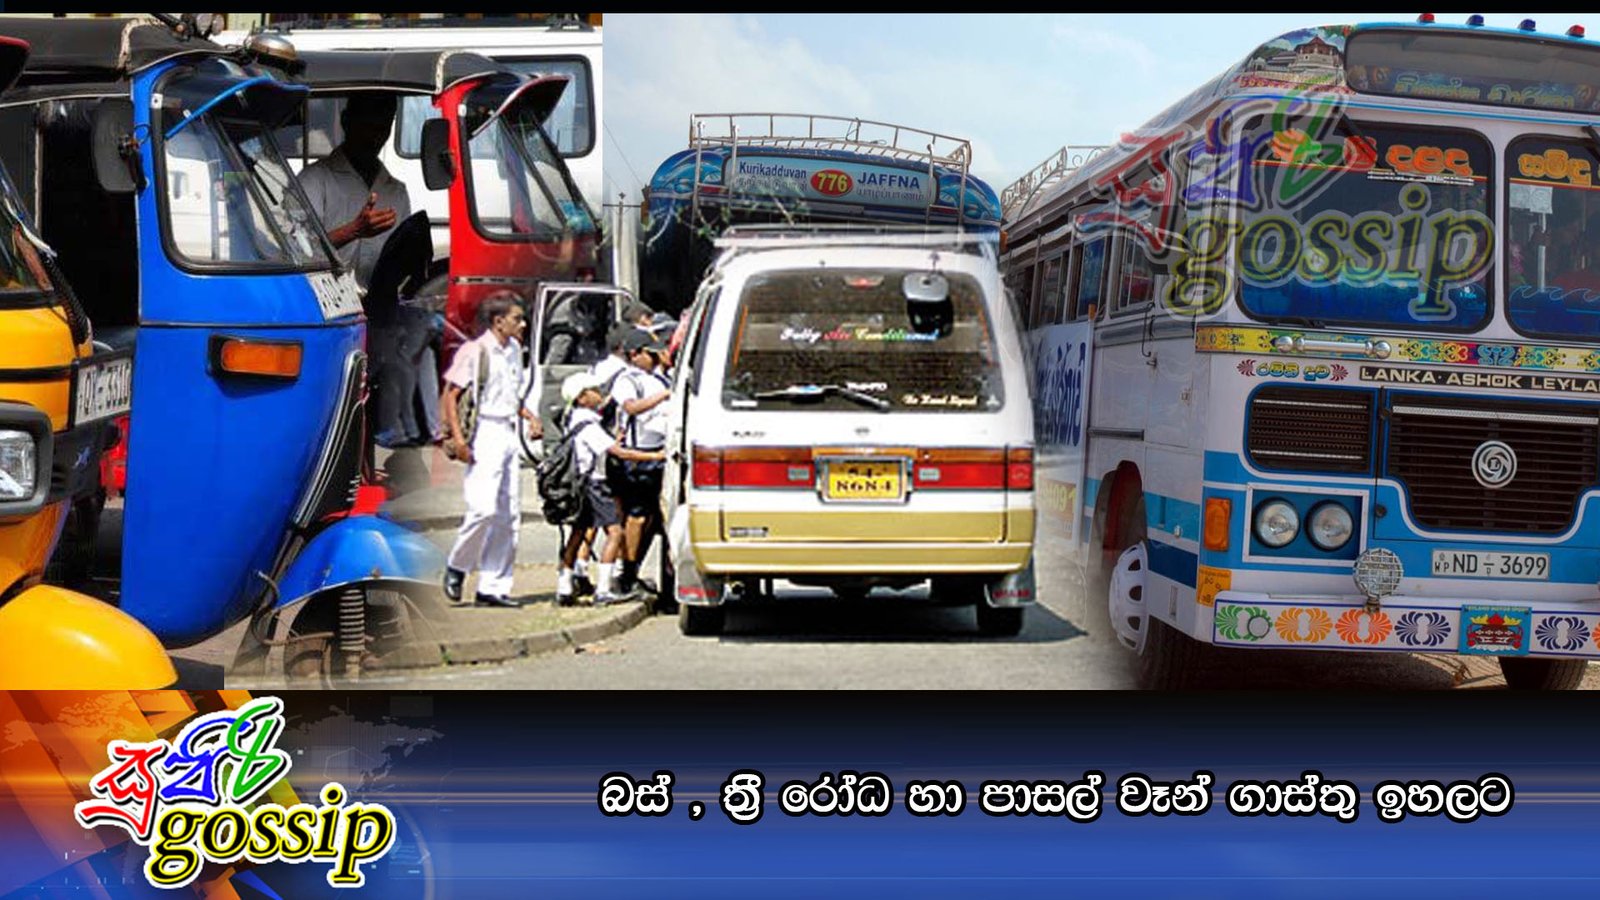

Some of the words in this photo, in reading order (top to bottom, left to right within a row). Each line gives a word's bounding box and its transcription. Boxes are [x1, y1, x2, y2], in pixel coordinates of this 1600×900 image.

[739, 161, 807, 179] Kurikadduvan
[857, 172, 920, 189] JAFFNA
[816, 172, 848, 193] 776
[1362, 366, 1437, 384] LANKA
[1446, 371, 1523, 389] ASHOK
[1453, 553, 1478, 573] ND
[1500, 555, 1548, 576] 3699
